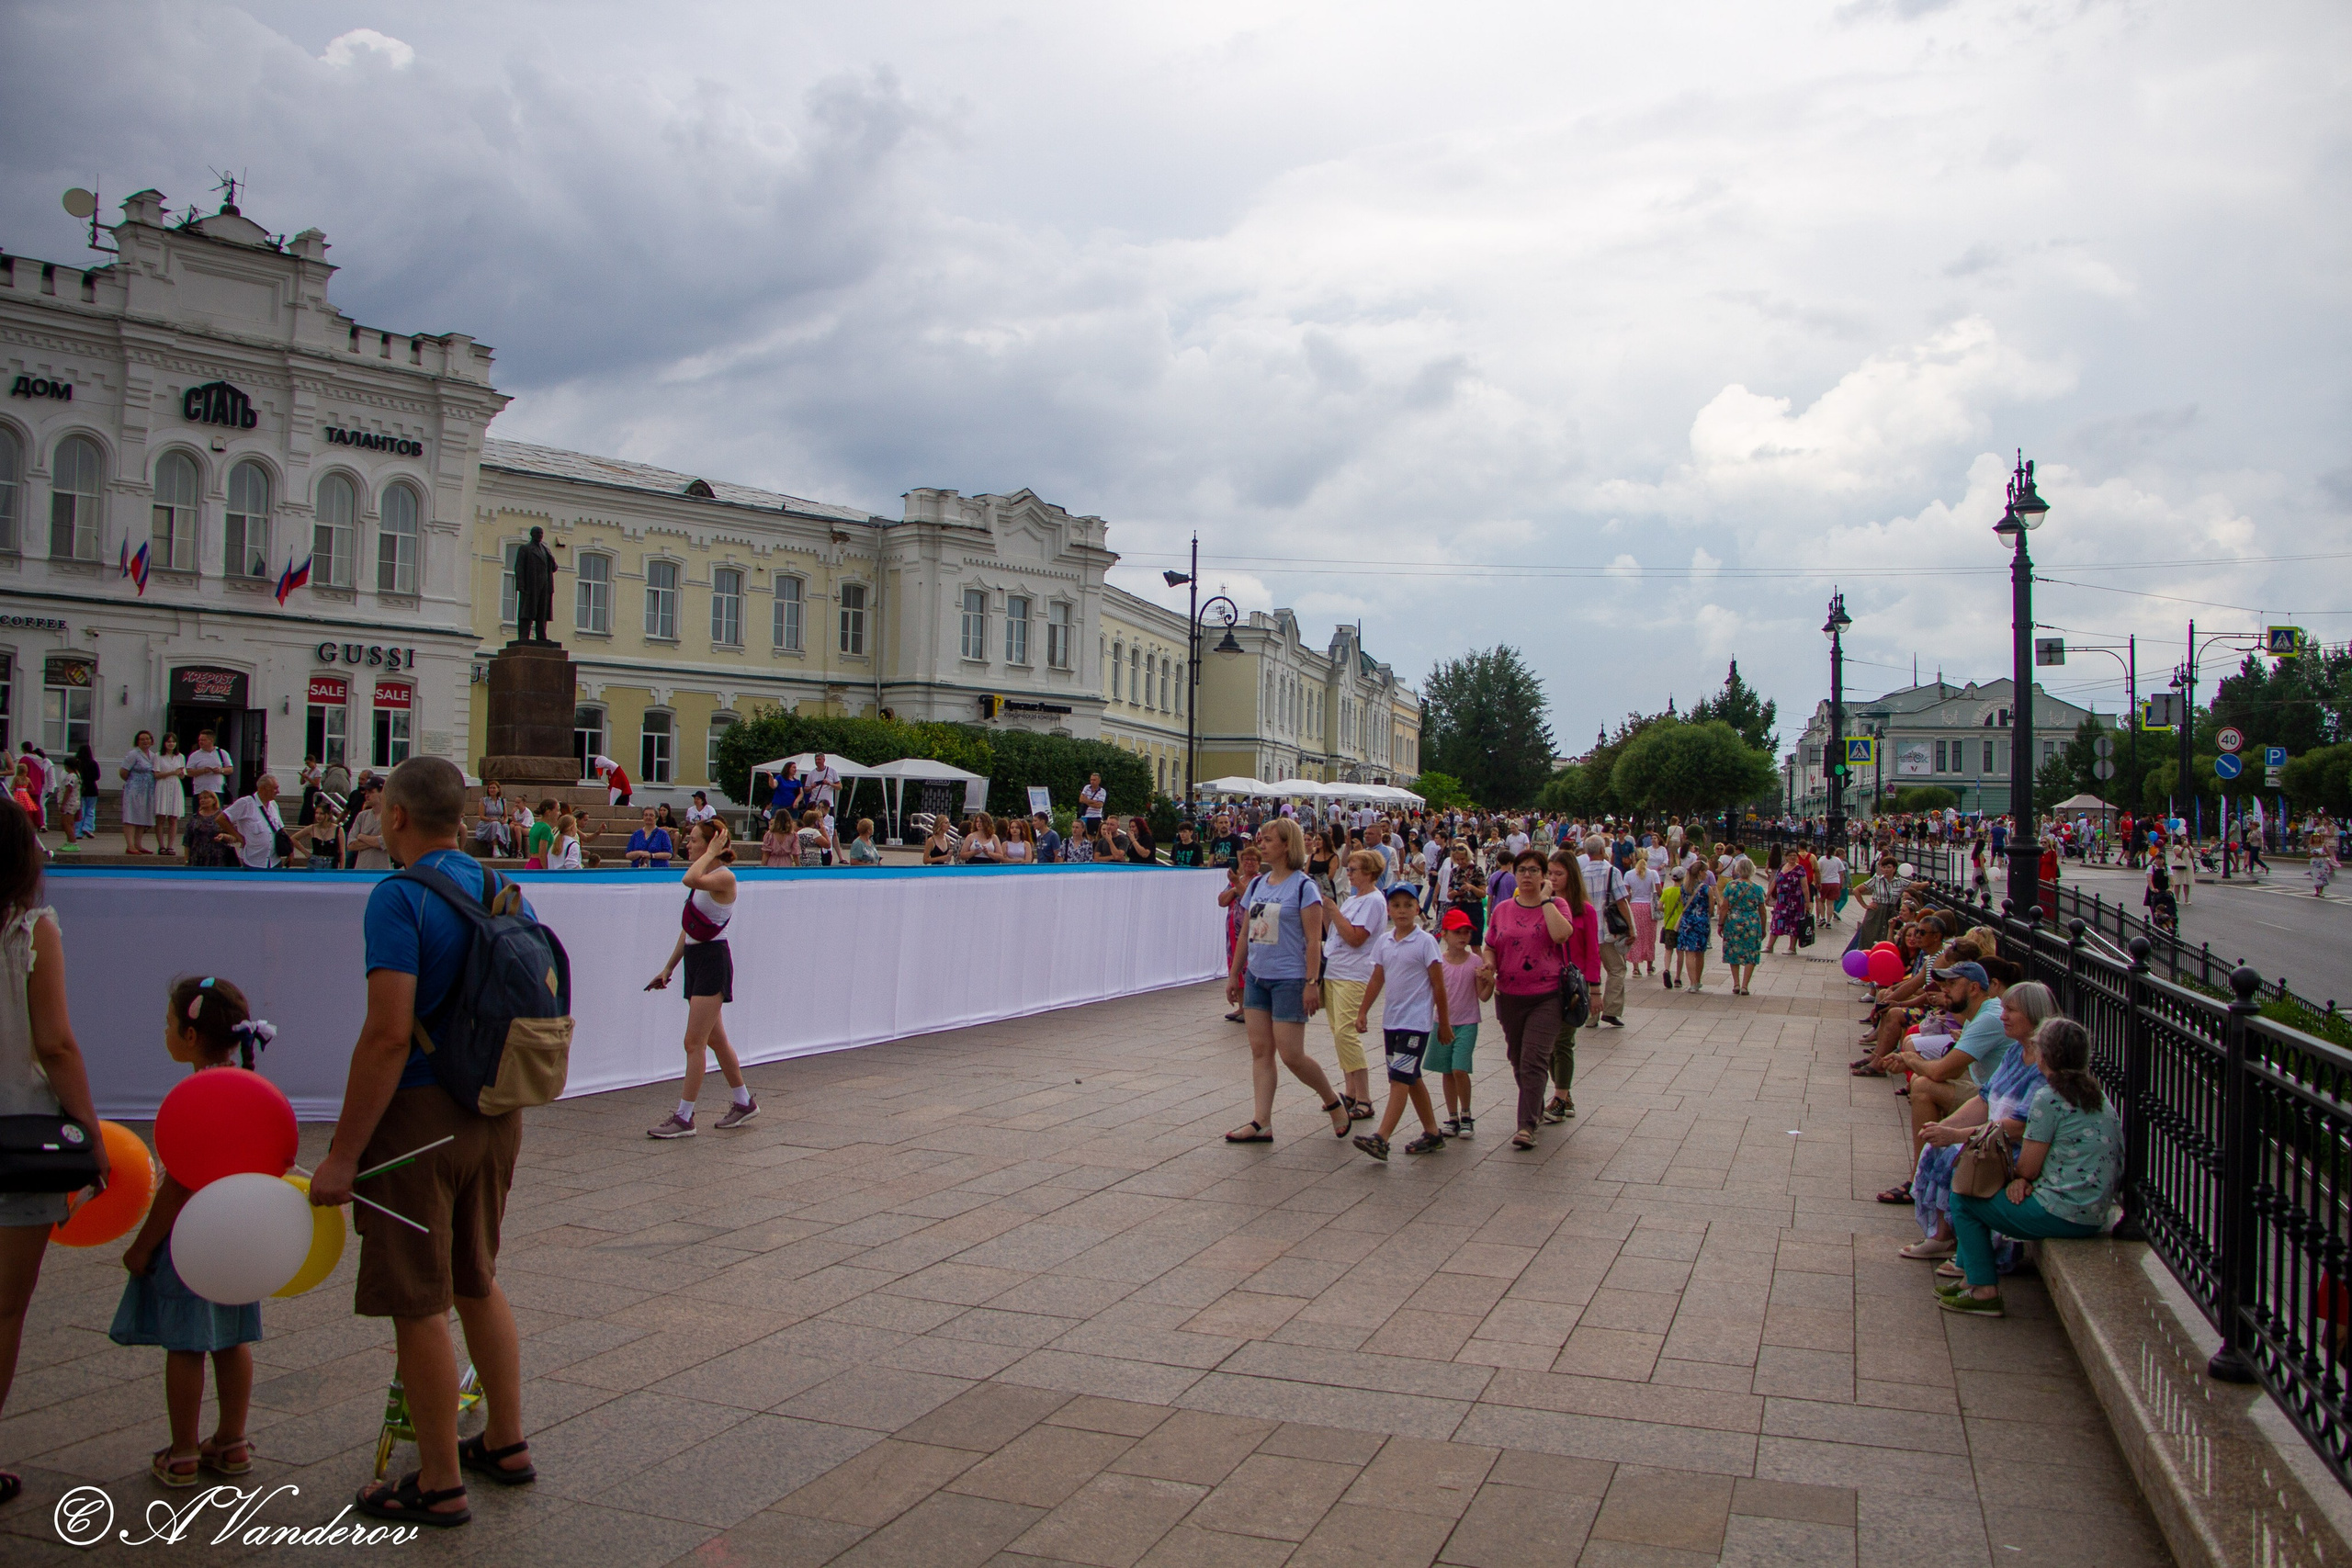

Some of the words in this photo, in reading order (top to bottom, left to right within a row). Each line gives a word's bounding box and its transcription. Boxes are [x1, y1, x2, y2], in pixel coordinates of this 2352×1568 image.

[12, 376, 73, 400] ДОМ
[184, 381, 258, 429] СТАТЬ
[324, 425, 424, 457] ТАЛАНТОВ
[0, 615, 67, 629] COFFEE
[316, 642, 415, 671] GUSSI
[182, 671, 238, 684] KREPOST
[193, 682, 232, 695] STORE
[310, 684, 345, 697] SALE
[375, 689, 410, 701] SALE
[2221, 735, 2237, 745] 40
